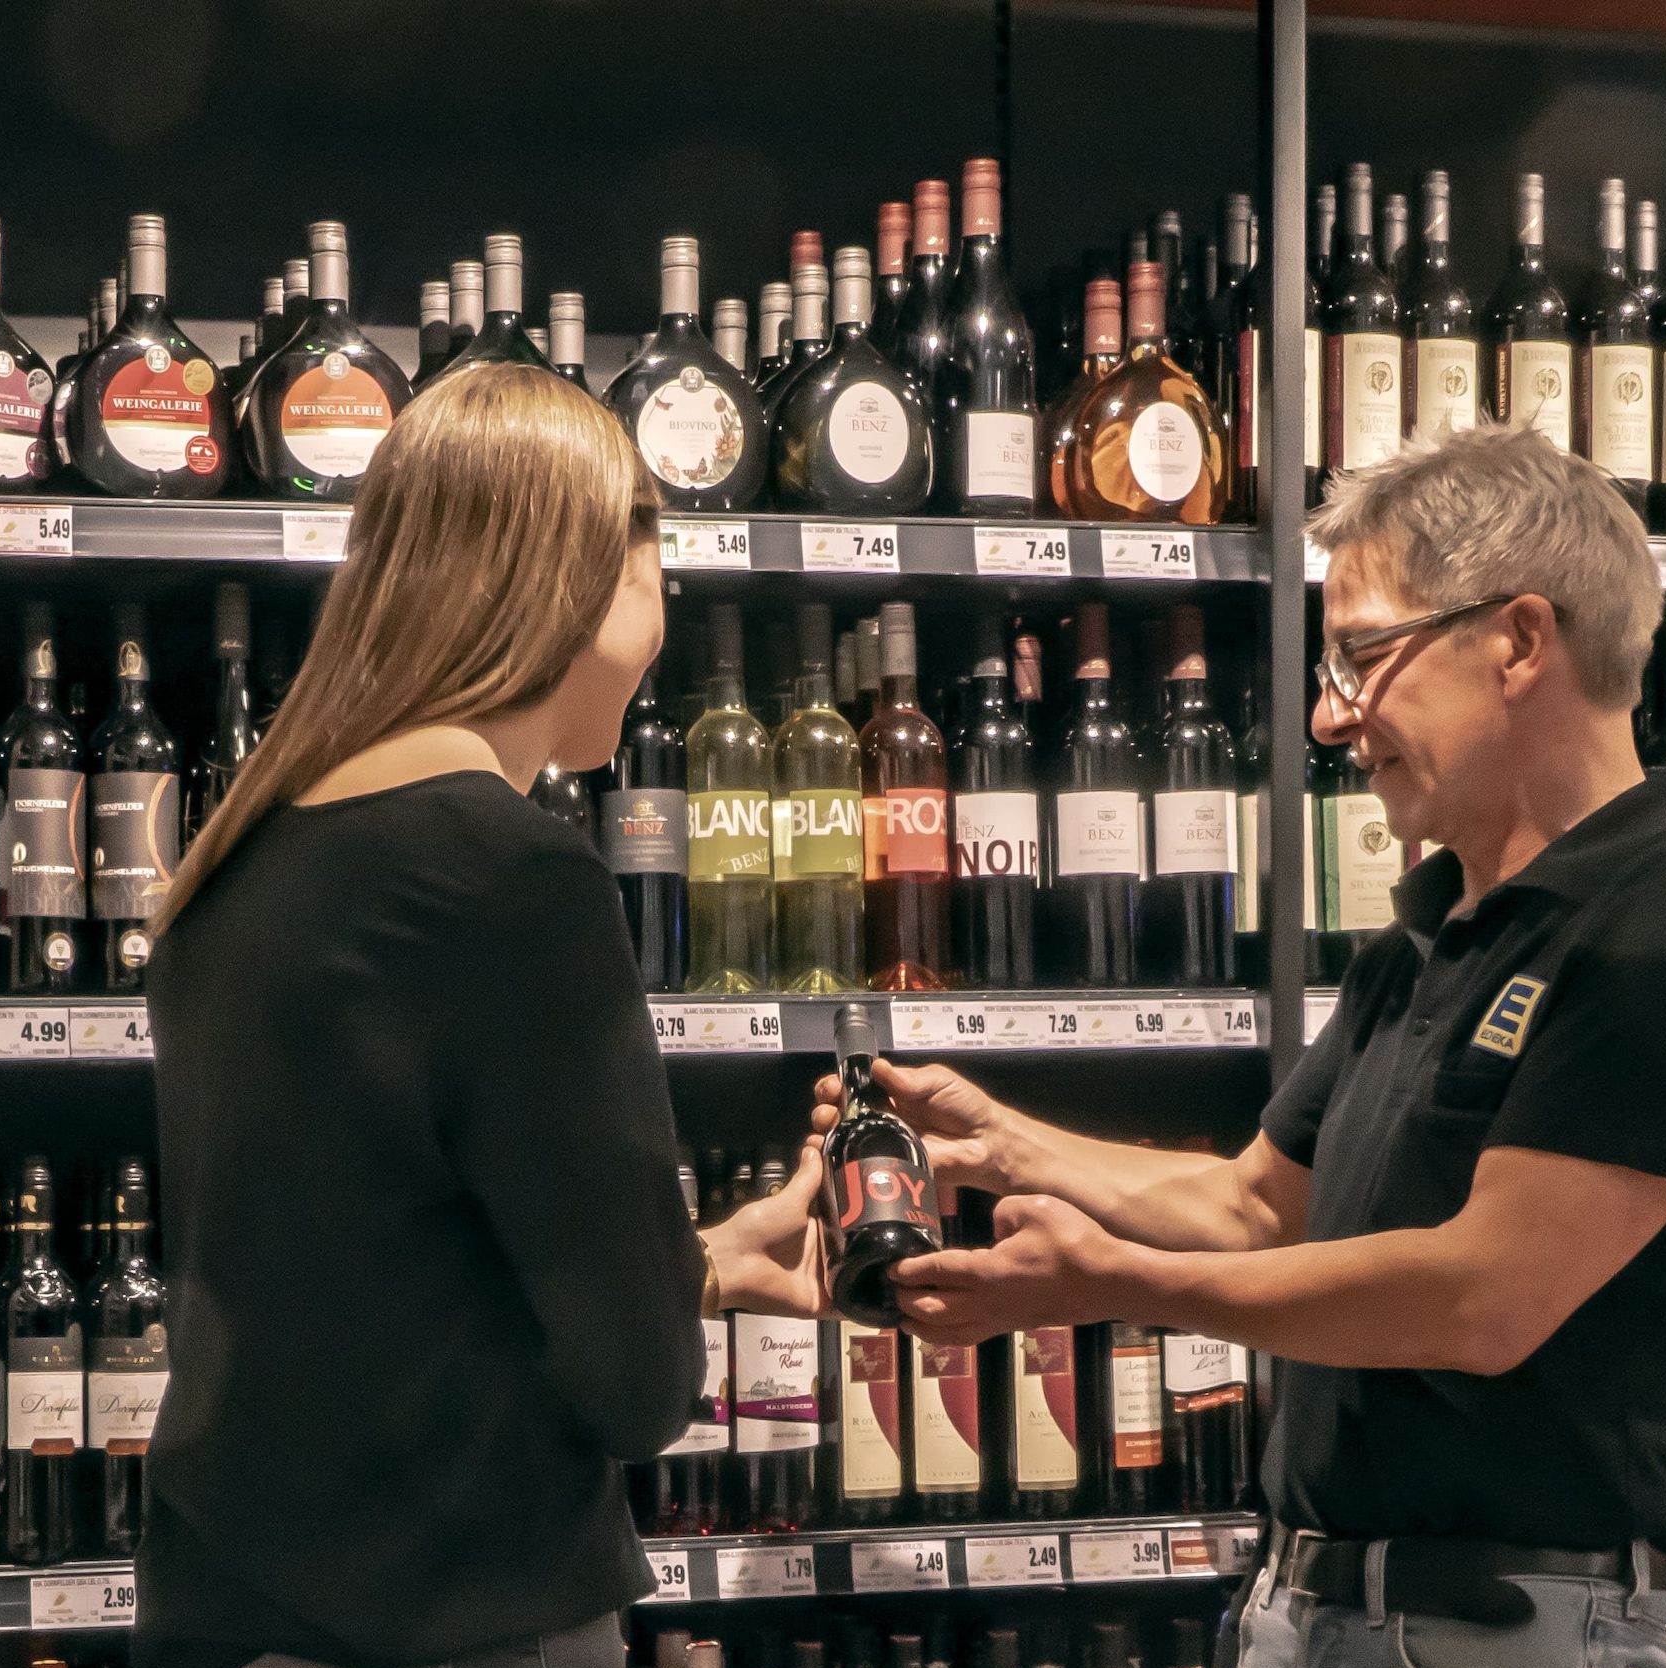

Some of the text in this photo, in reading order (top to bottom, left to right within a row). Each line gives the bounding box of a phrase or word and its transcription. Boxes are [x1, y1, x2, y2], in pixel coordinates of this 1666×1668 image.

[113, 397, 203, 413] WEINGALERIE
[290, 404, 383, 417] WEINGALERIE
[669, 420, 718, 431] BIOVINO
[852, 419, 887, 433] BENZ
[1149, 438, 1184, 453] BENZ
[1003, 450, 1030, 464] BENZ
[38, 517, 71, 541] 5.49
[717, 534, 747, 555] 5.49
[853, 536, 895, 557] 7.49
[1026, 541, 1066, 561] 7.49
[1151, 543, 1191, 563] 7.49
[15, 799, 68, 809] DORNFELDER
[623, 822, 664, 836] BENZ
[1087, 827, 1125, 841] BENZ
[1185, 827, 1223, 842] BENZ
[750, 1009, 779, 1036] 6.99
[956, 1007, 985, 1034] 6.99
[1048, 1007, 1077, 1033] 7.29
[1135, 1007, 1163, 1032] 6.99
[1224, 1005, 1252, 1030] 7.49
[21, 1021, 66, 1042] 4.99
[1479, 1029, 1515, 1052] EDEKA
[839, 1159, 926, 1228] JOY
[761, 1336, 814, 1355] Dornfelder
[1191, 1342, 1231, 1358] LIGHT
[779, 1352, 803, 1369] Rosé
[915, 1552, 943, 1573] 2.49
[1029, 1546, 1057, 1568] 2.49
[1133, 1541, 1161, 1564] 3.99
[783, 1558, 812, 1580] 1.79
[104, 1587, 135, 1608] 2.99
